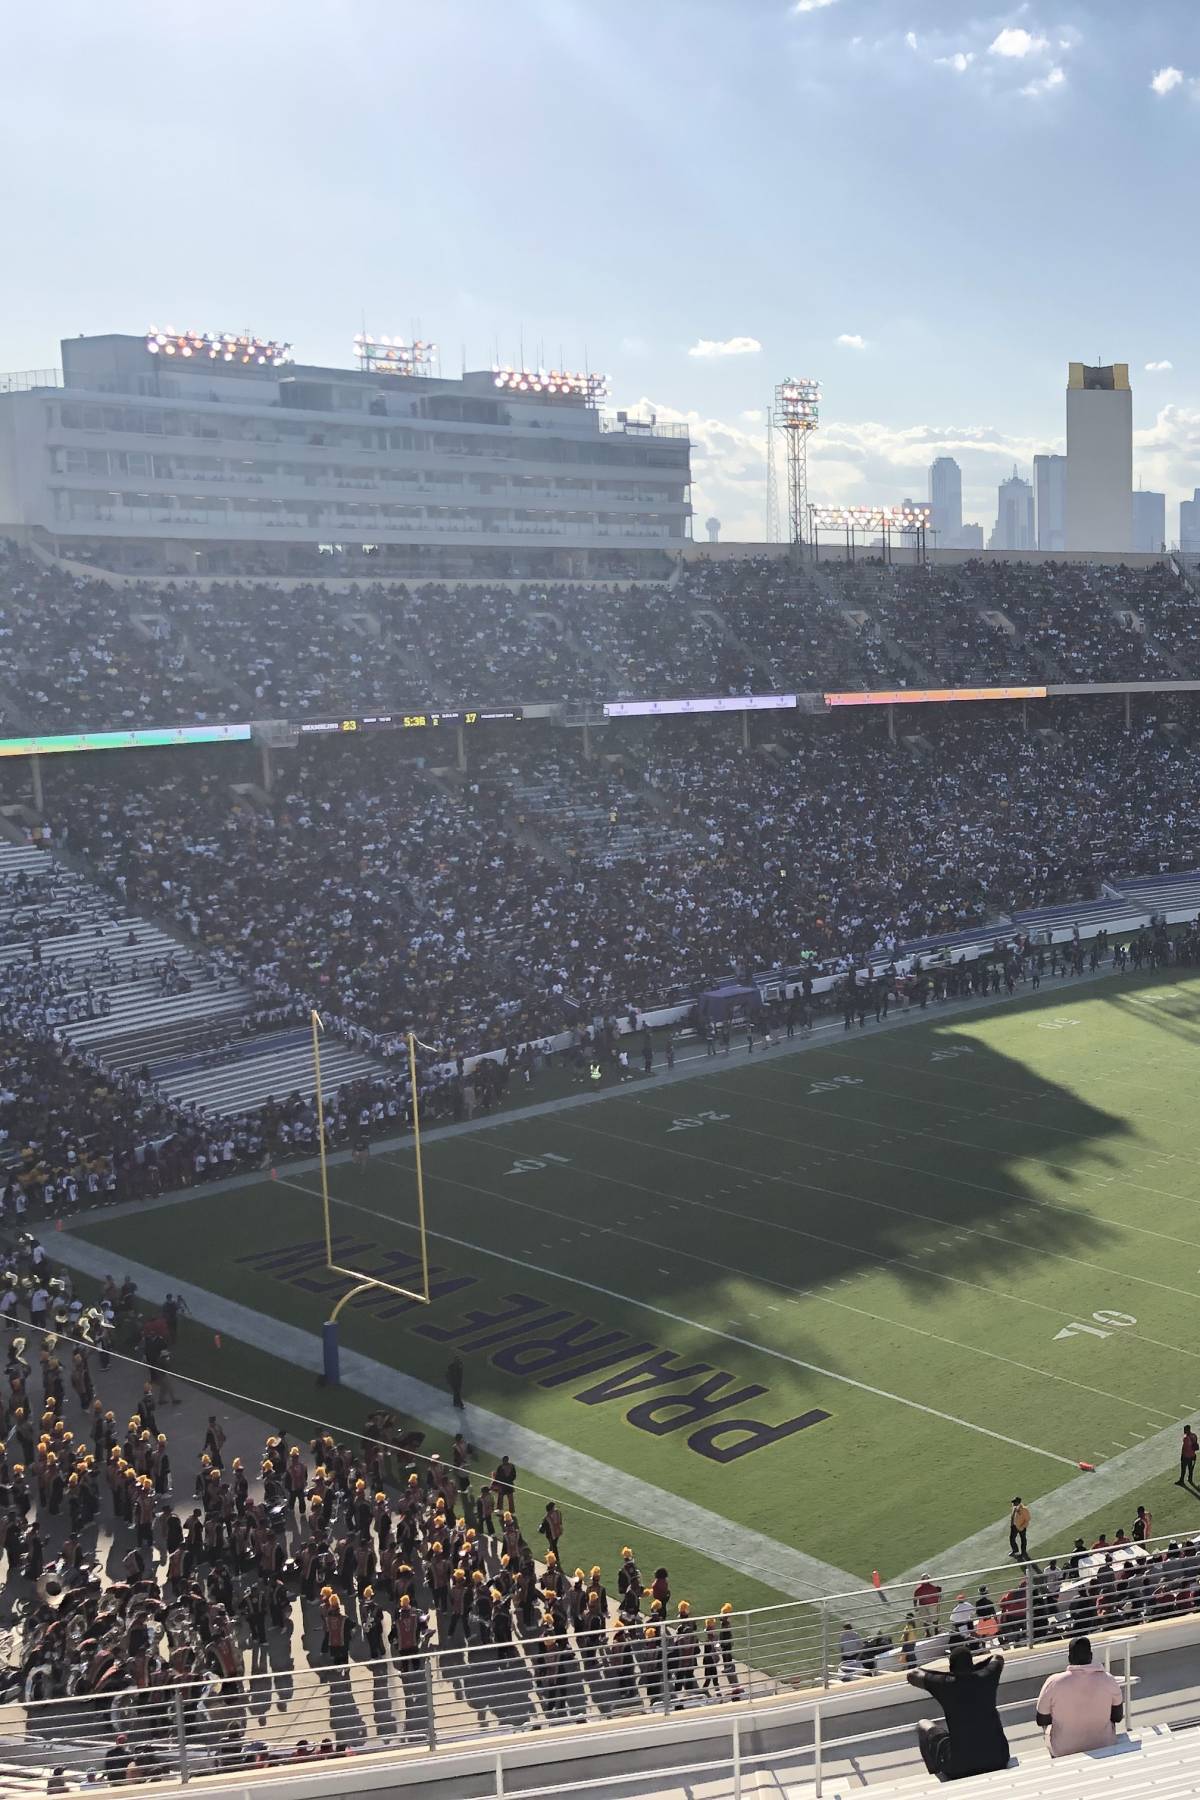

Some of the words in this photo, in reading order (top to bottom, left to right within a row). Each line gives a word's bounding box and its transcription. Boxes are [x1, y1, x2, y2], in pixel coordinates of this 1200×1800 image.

[343, 720, 356, 731] 23
[403, 716, 426, 727] 5:36
[465, 713, 477, 723] 17
[809, 1075, 864, 1092] 30
[671, 1110, 732, 1128] 20
[512, 1152, 573, 1170] 10
[234, 1234, 481, 1320] VIEW
[1064, 1309, 1138, 1339] 10
[410, 1292, 833, 1464] PRAIRIE
